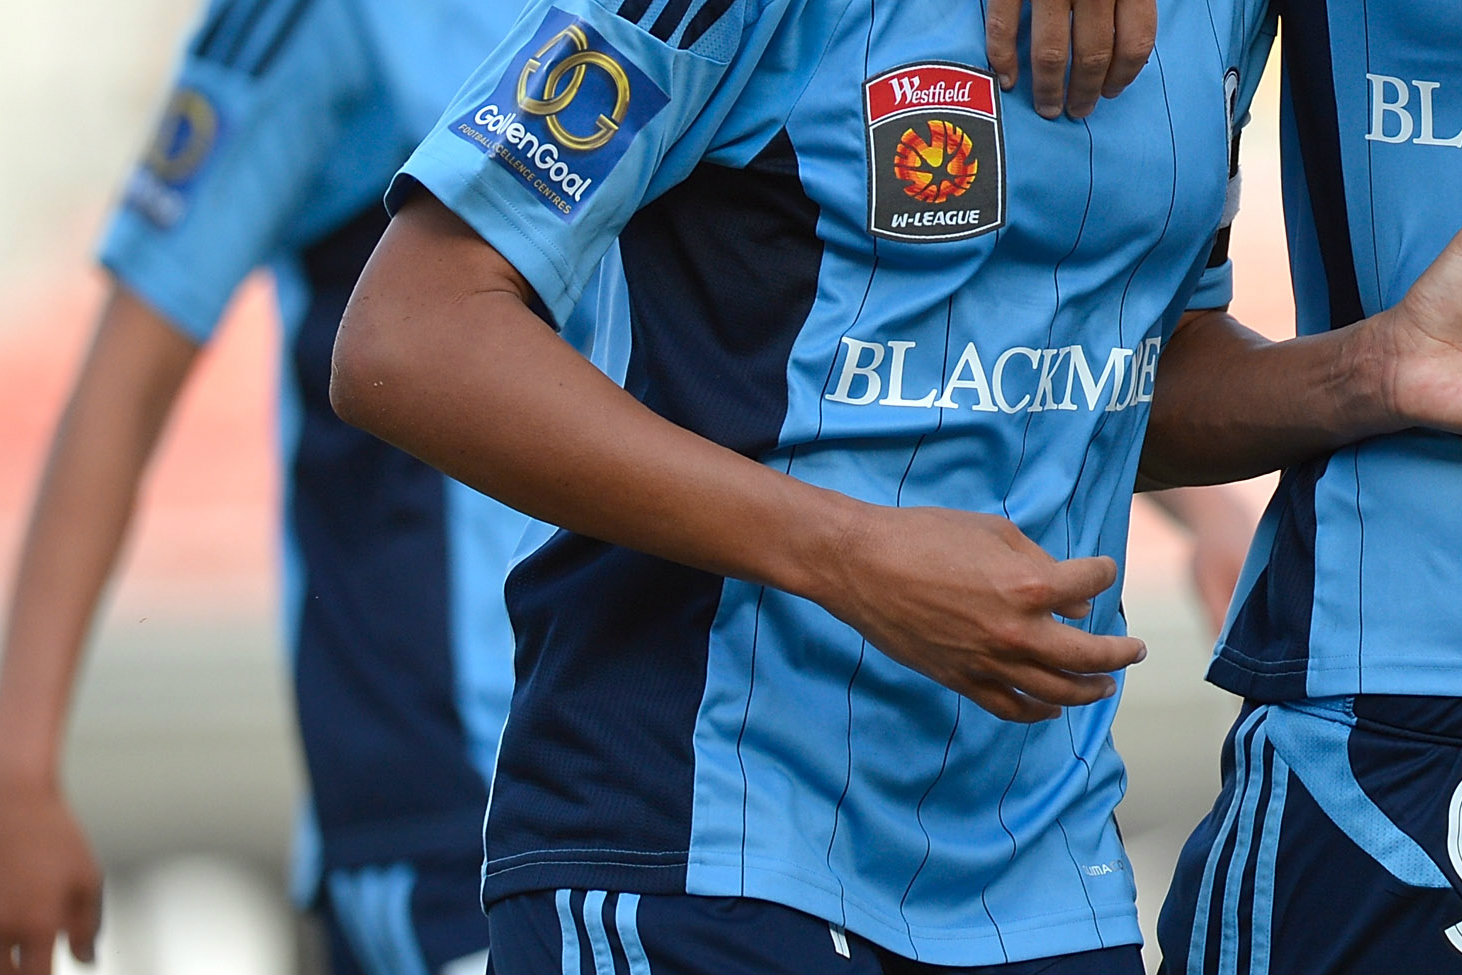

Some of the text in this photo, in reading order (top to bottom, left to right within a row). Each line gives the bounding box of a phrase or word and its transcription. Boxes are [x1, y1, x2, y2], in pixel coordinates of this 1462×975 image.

[888, 74, 974, 106] Westfield
[457, 122, 572, 215] FOOTBALL CELLENCE CENTRES
[890, 209, 981, 229] W-LEAGUE
[824, 335, 1162, 415] BLACKME
